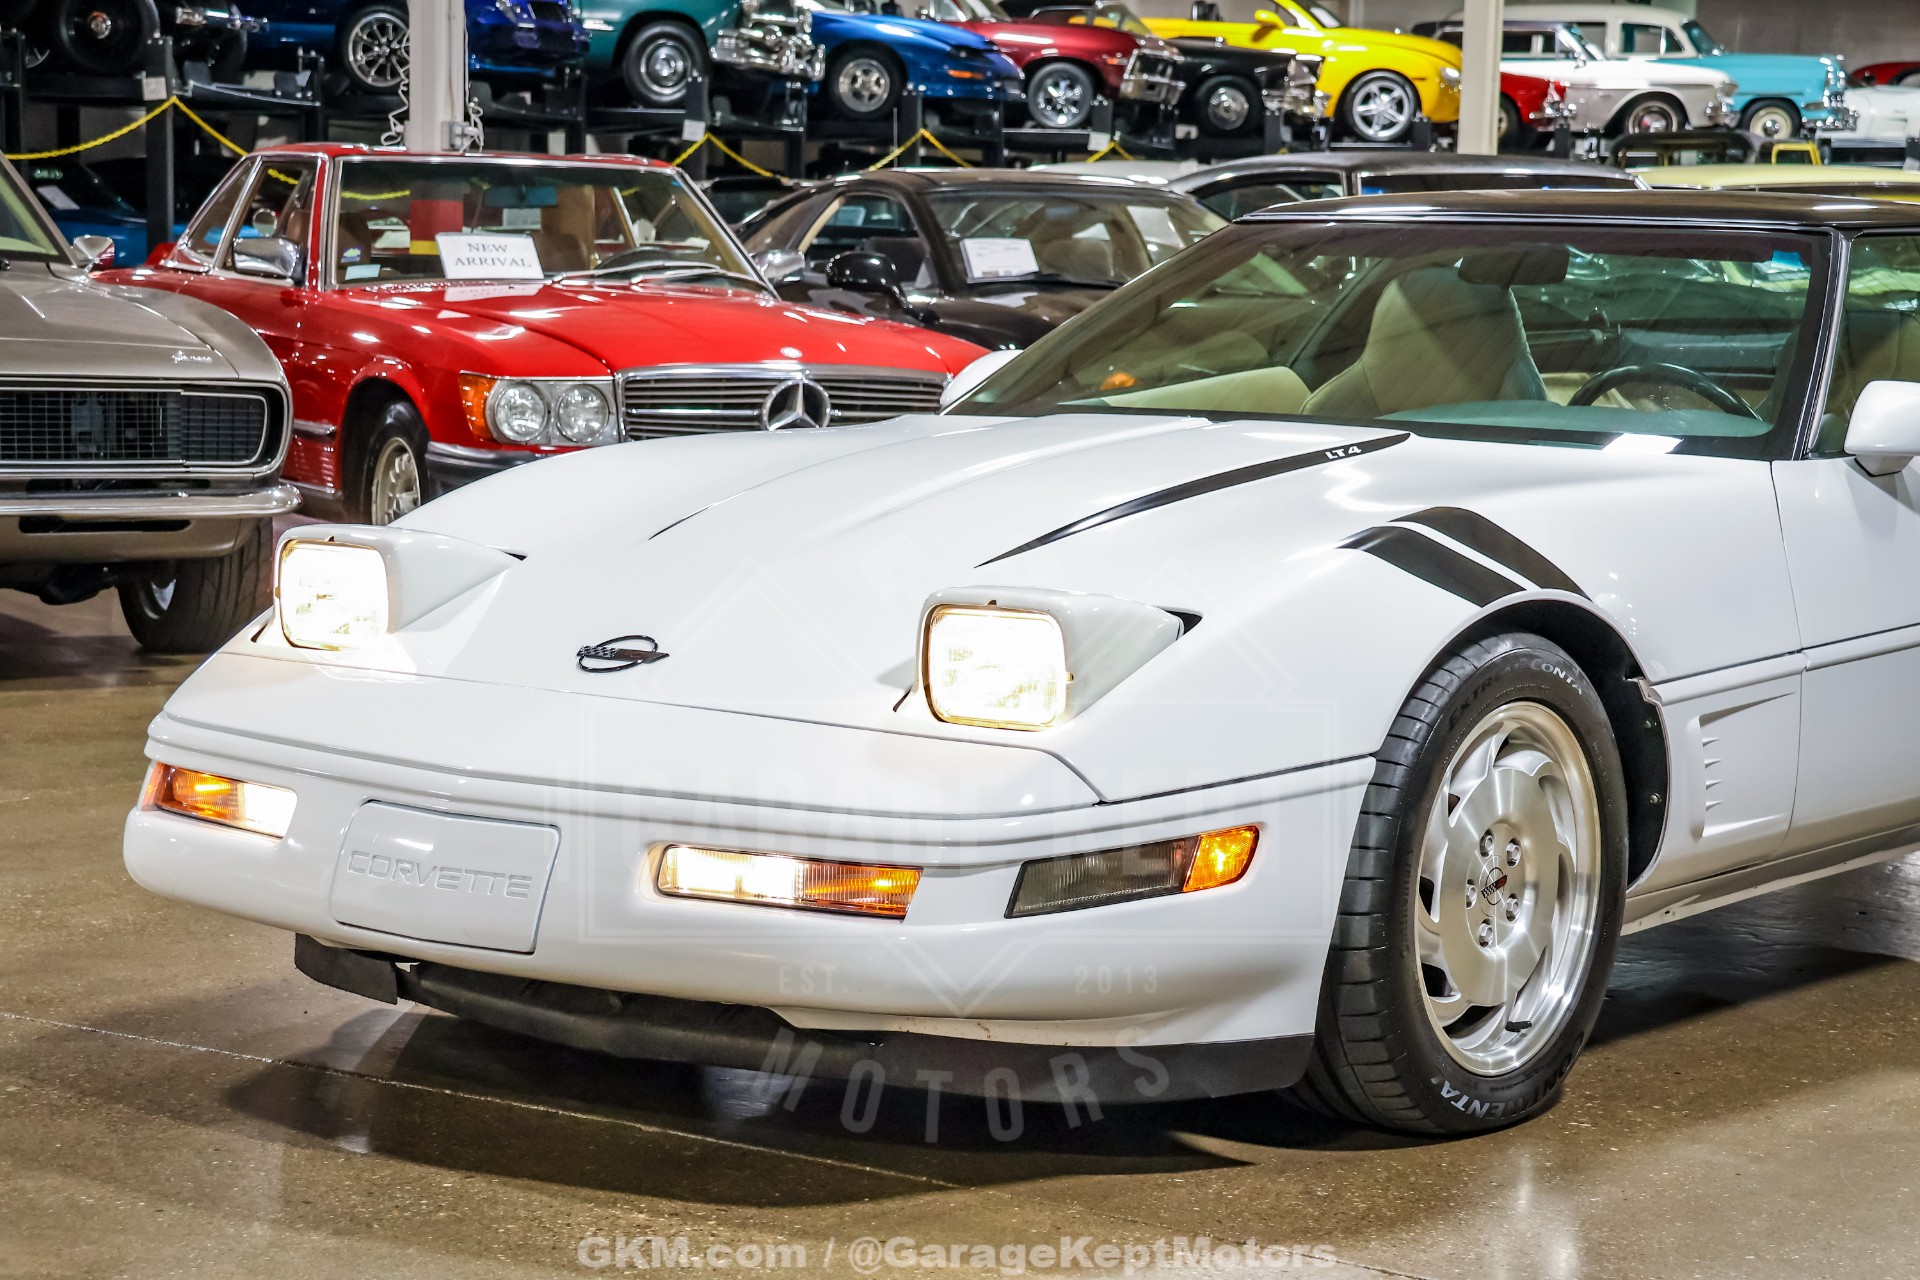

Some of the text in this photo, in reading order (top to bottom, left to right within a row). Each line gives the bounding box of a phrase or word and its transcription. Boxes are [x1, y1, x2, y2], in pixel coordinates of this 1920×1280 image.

[467, 243, 508, 253] NEW
[455, 257, 532, 268] ARRIVAL
[348, 850, 532, 899] CORVETTE
